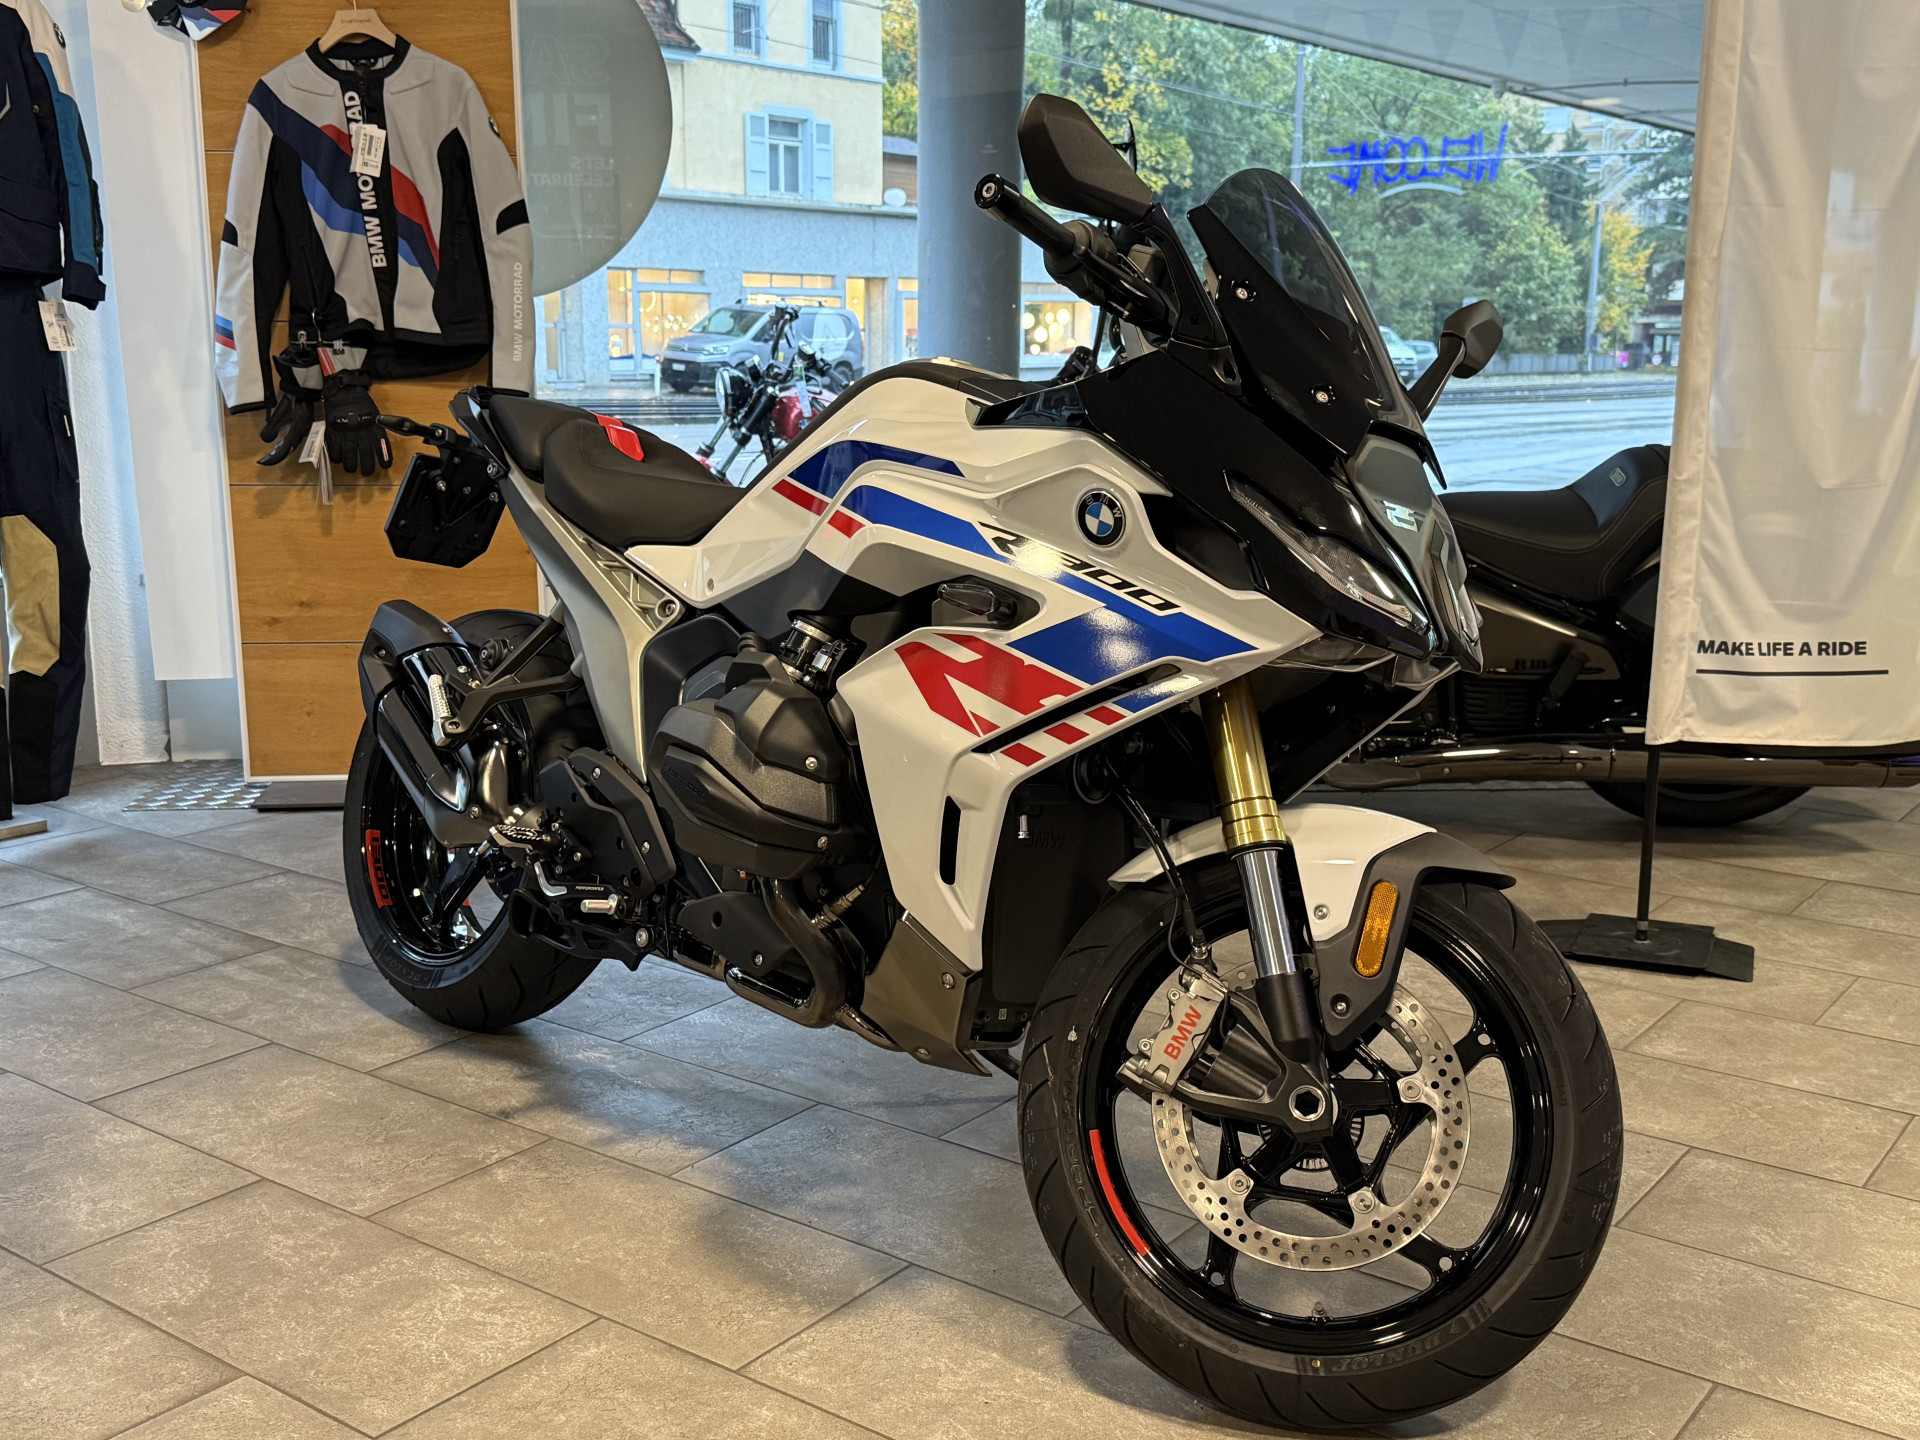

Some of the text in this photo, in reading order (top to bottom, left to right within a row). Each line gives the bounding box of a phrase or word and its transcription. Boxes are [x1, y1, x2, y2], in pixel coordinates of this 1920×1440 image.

[344, 90, 377, 211] MOAD
[364, 216, 388, 268] BMW
[513, 262, 523, 362] BMW MOTORRAD
[1697, 640, 1867, 657] MAKE LIFE A RIDE
[1163, 1004, 1202, 1061] BMW
[1062, 1028, 1099, 1228] SPORTSMAR
